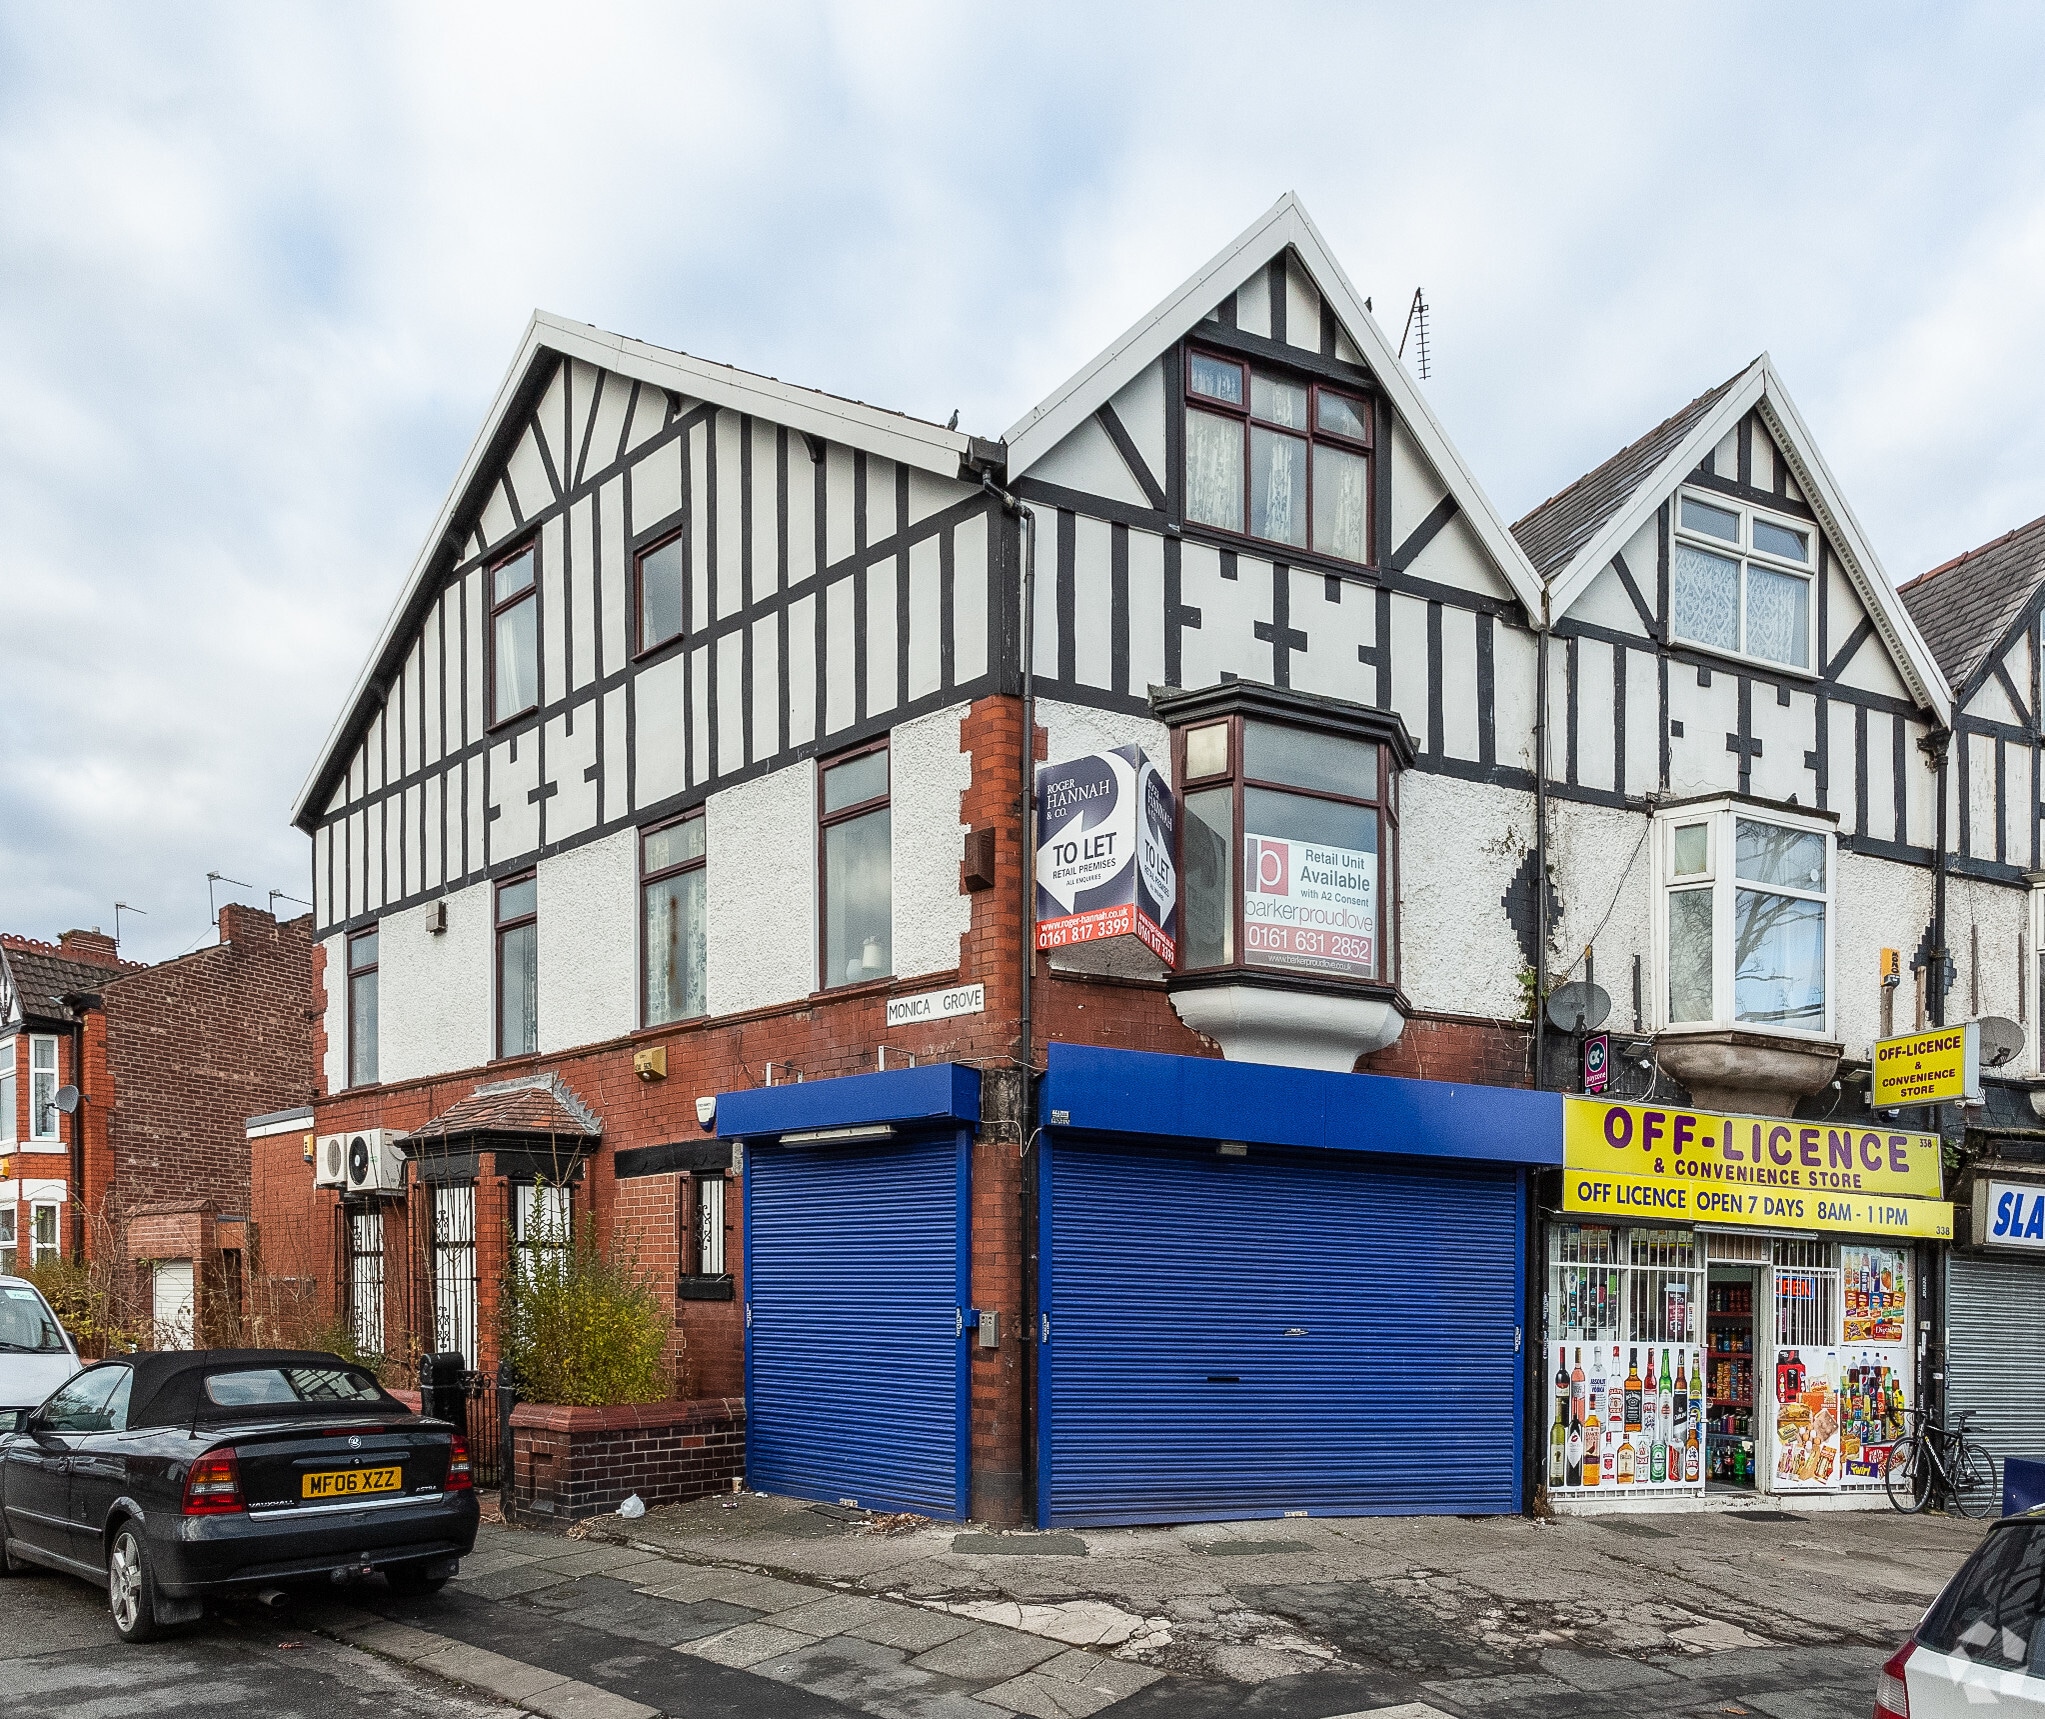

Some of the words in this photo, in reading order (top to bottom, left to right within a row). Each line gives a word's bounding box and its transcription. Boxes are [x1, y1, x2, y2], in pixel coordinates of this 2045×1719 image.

[1047, 778, 1076, 795] ROGER
[1047, 779, 1110, 810] HANNAH
[1047, 811, 1053, 821] &
[1052, 841, 1078, 867] TO
[1084, 831, 1117, 861] LET
[1305, 848, 1338, 866] Retail
[1342, 854, 1365, 870] Unit
[1052, 866, 1077, 880] RETAIL
[1079, 857, 1117, 875] PREMISES
[1144, 838, 1155, 869] TO
[1157, 853, 1170, 885] LET
[1076, 873, 1102, 884] ENQUIRIES
[1300, 865, 1370, 892] Available
[1300, 888, 1319, 900] with
[1320, 891, 1332, 902] A2
[1334, 893, 1369, 908] Consent
[1040, 907, 1129, 931] www.roger-hannah.co.uk
[1245, 896, 1373, 932] barkerproudlove
[1039, 929, 1067, 947] 0161
[1071, 924, 1093, 941] 817
[1098, 917, 1129, 937] 3399
[1137, 921, 1151, 944] 0161
[1248, 925, 1287, 949] 0161
[1295, 930, 1324, 953] 631
[1331, 935, 1369, 960] 2852
[888, 998, 931, 1021] MONICA
[943, 989, 982, 1011] GROVE
[1878, 1035, 1962, 1062] OFF-LICENCE
[1914, 1061, 1922, 1070] &
[1882, 1068, 1956, 1088] CONVENIENCE
[1900, 1084, 1935, 1098] STORE
[1603, 1105, 1911, 1174] OFF-LICENCE
[1919, 1138, 1933, 1149] 338
[1653, 1157, 1666, 1173] &
[1674, 1158, 1800, 1185] CONVENIENCE
[1808, 1170, 1862, 1189] STORE
[1577, 1180, 1611, 1202] OFF
[1616, 1184, 1687, 1209] LICENCE
[1696, 1190, 1744, 1214] OPEN
[1747, 1195, 1758, 1214] 7
[1763, 1197, 1804, 1218] DAYS
[1817, 1201, 1852, 1222] 8AM
[1866, 1204, 1909, 1227] 11PM
[1935, 1225, 1950, 1236] 338
[1850, 1462, 1872, 1477] Twirl
[309, 1472, 358, 1495] MF06
[361, 1470, 395, 1490] XZZ
